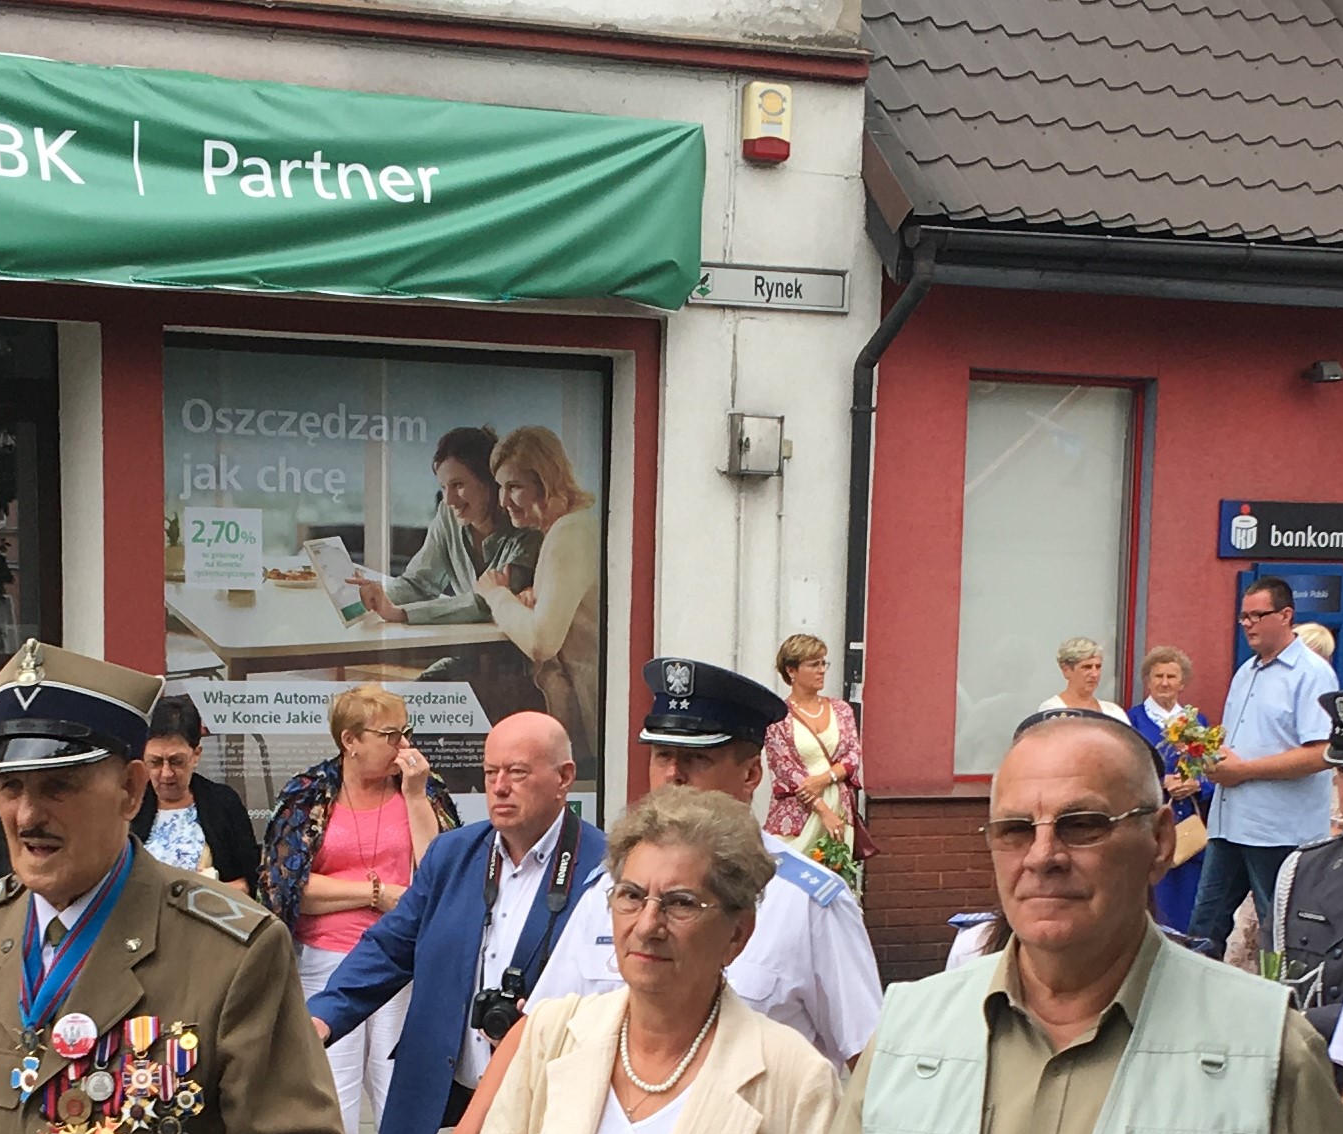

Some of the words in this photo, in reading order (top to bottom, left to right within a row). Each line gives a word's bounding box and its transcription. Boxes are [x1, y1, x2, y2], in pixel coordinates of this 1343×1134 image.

[202, 139, 440, 203] Partner
[754, 275, 803, 303] Rynek
[181, 398, 427, 447] Oszczędzam
[179, 453, 243, 500] jak
[257, 454, 347, 503] chcę
[191, 519, 256, 547] 2,70%
[203, 691, 269, 708] Włączam
[273, 691, 334, 705] Automat
[214, 713, 227, 724] w
[233, 711, 281, 724] Koncie
[286, 711, 323, 724] Jakie
[430, 711, 474, 727] więcej
[556, 851, 571, 885] Canon
